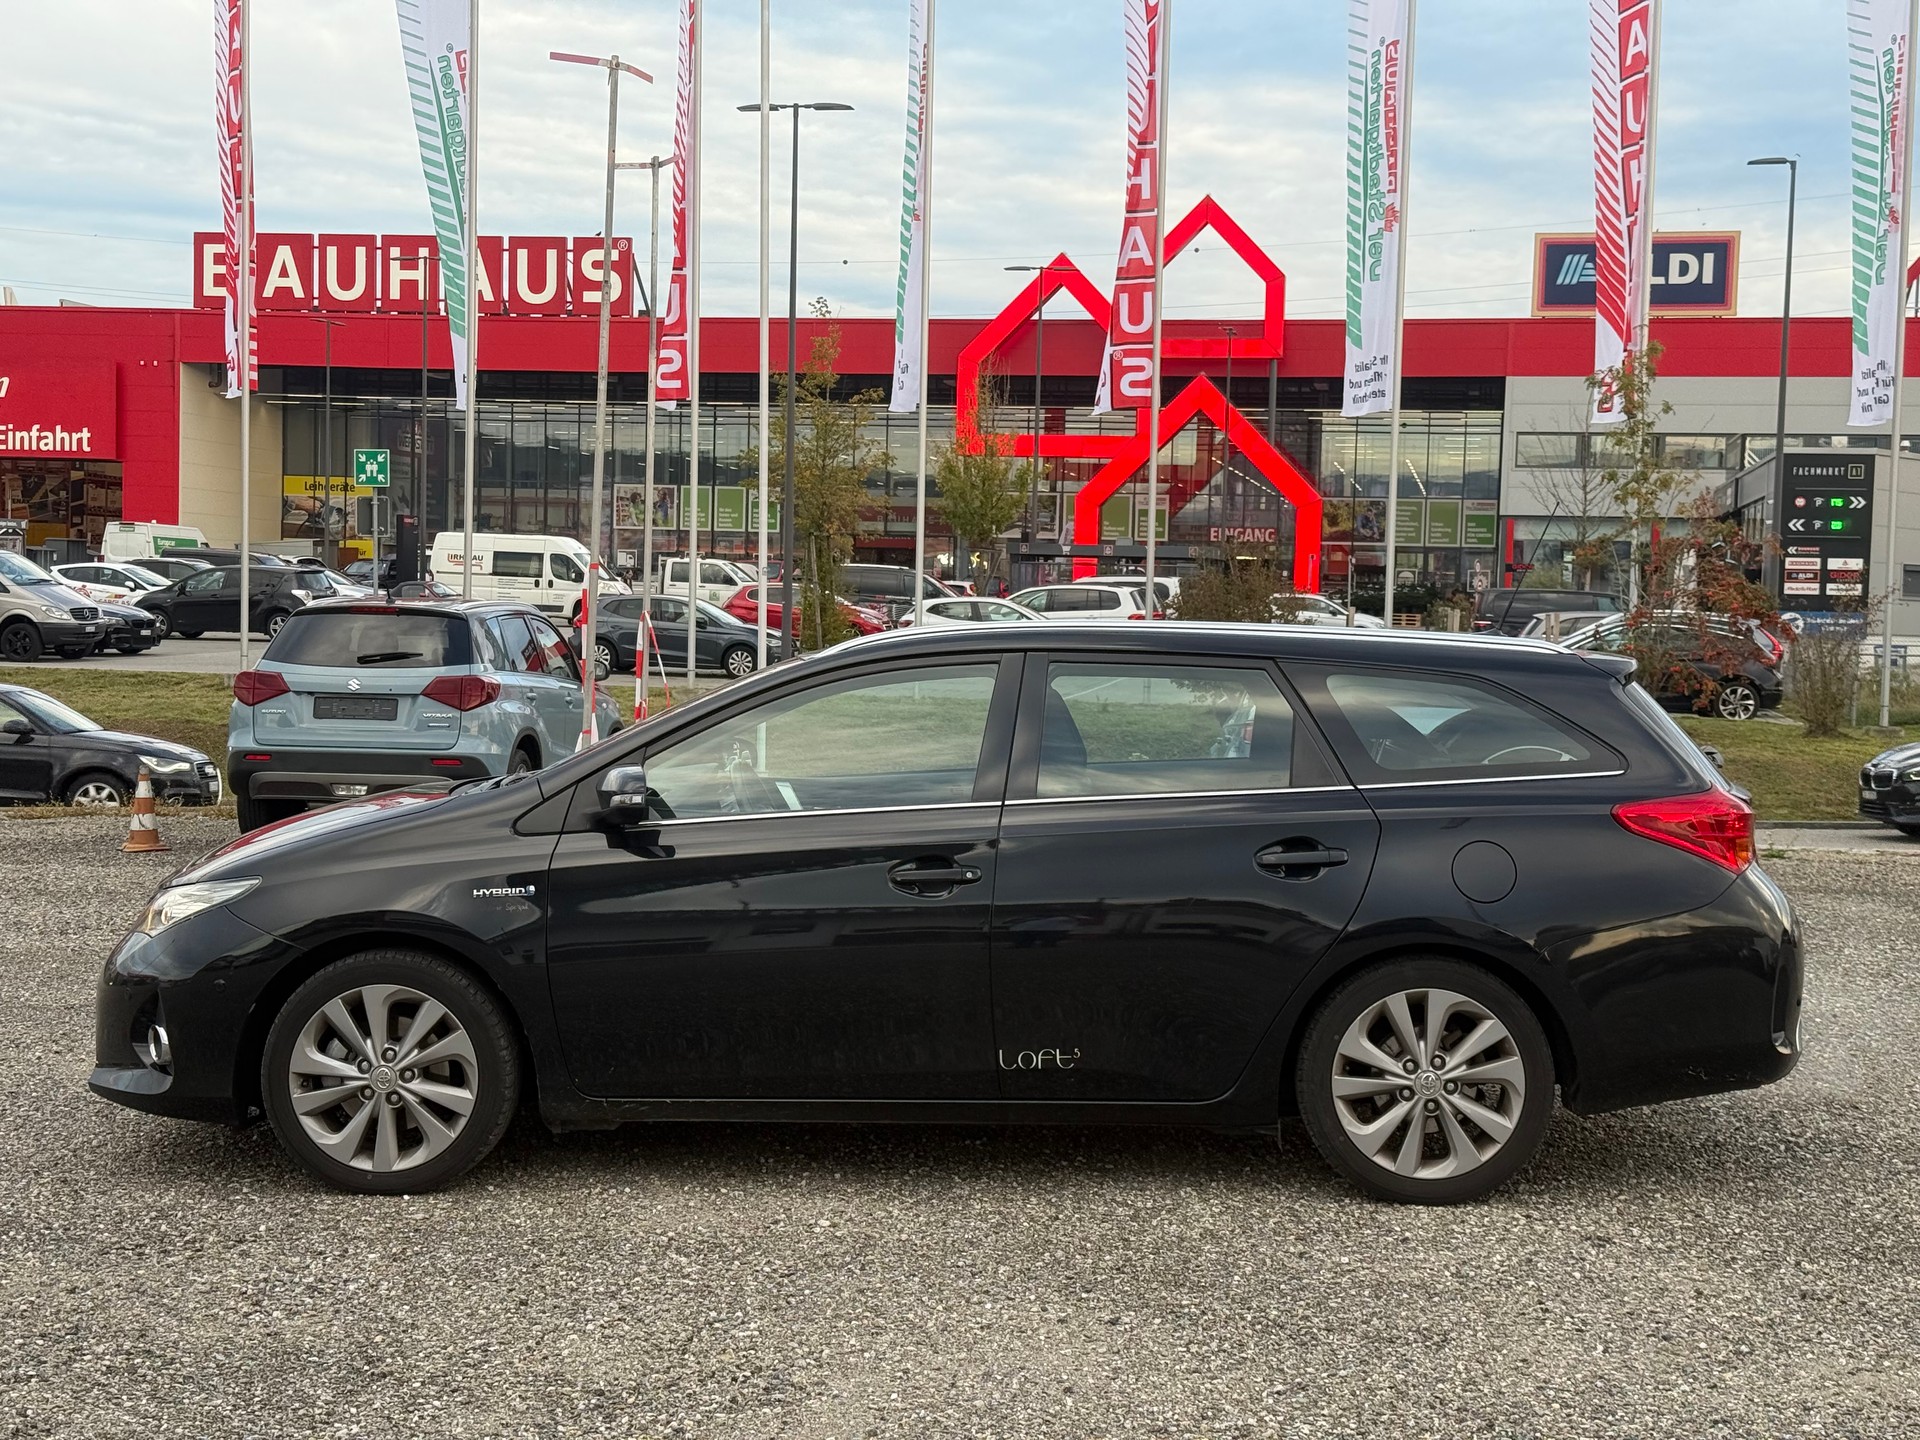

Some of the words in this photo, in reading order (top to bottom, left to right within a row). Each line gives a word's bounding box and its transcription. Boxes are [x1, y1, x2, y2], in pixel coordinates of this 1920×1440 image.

[1649, 253, 1715, 285] LDI
[1793, 466, 1845, 476] FACHMARKT
[304, 481, 355, 493] Leiheräte
[1210, 527, 1276, 542] EINGANG
[473, 887, 526, 898] HYBRID
